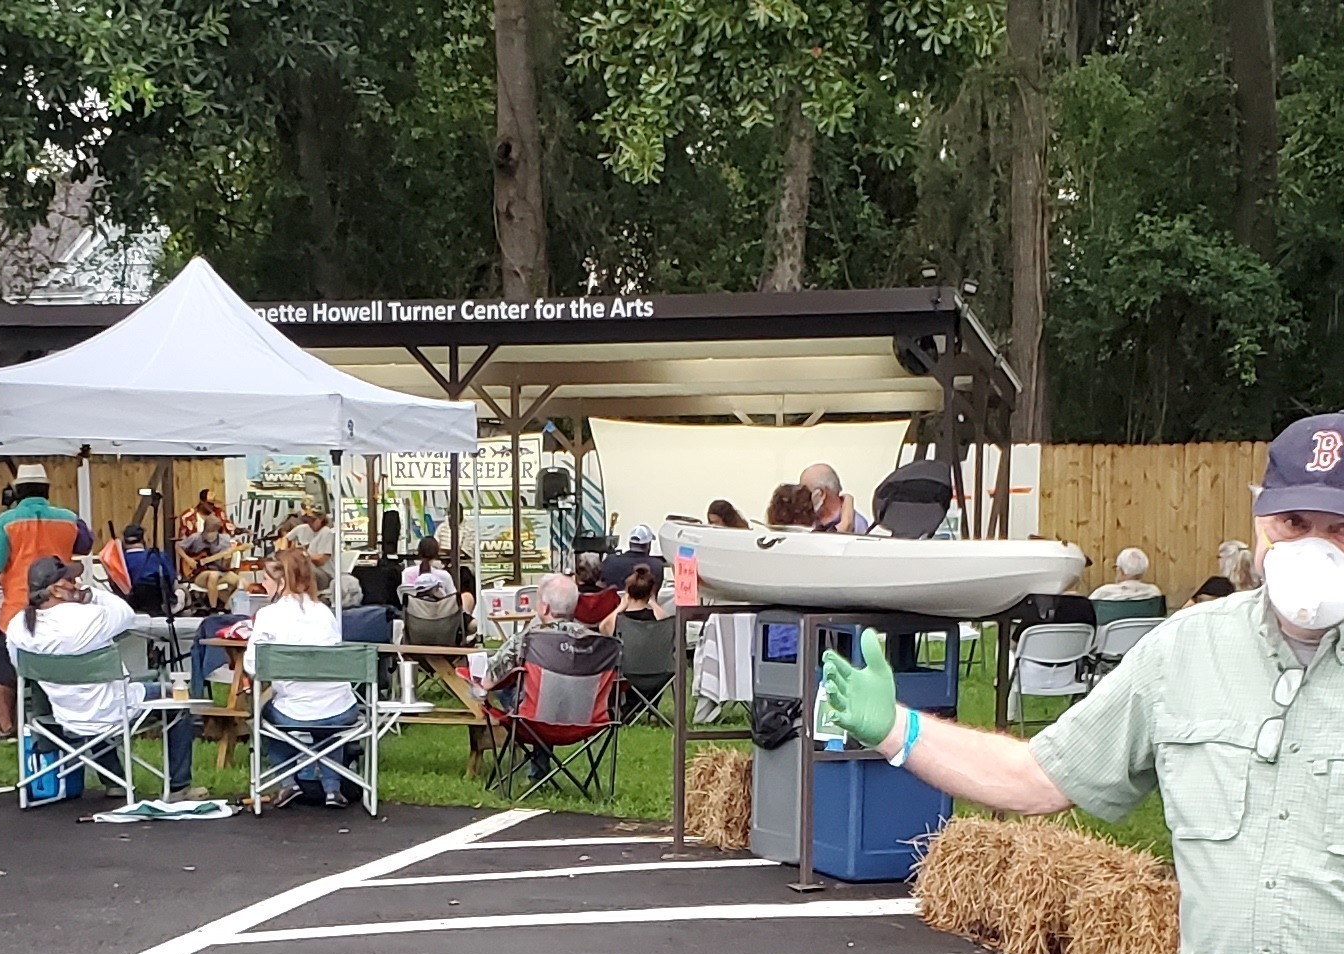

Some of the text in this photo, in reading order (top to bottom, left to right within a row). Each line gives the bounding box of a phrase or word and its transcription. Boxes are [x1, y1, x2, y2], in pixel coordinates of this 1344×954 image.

[254, 297, 654, 323] nette Howell Turner Center for the Arts
[1305, 430, 1344, 473] B
[264, 473, 304, 481] WWA
[394, 461, 534, 479] RIVERKEEPR
